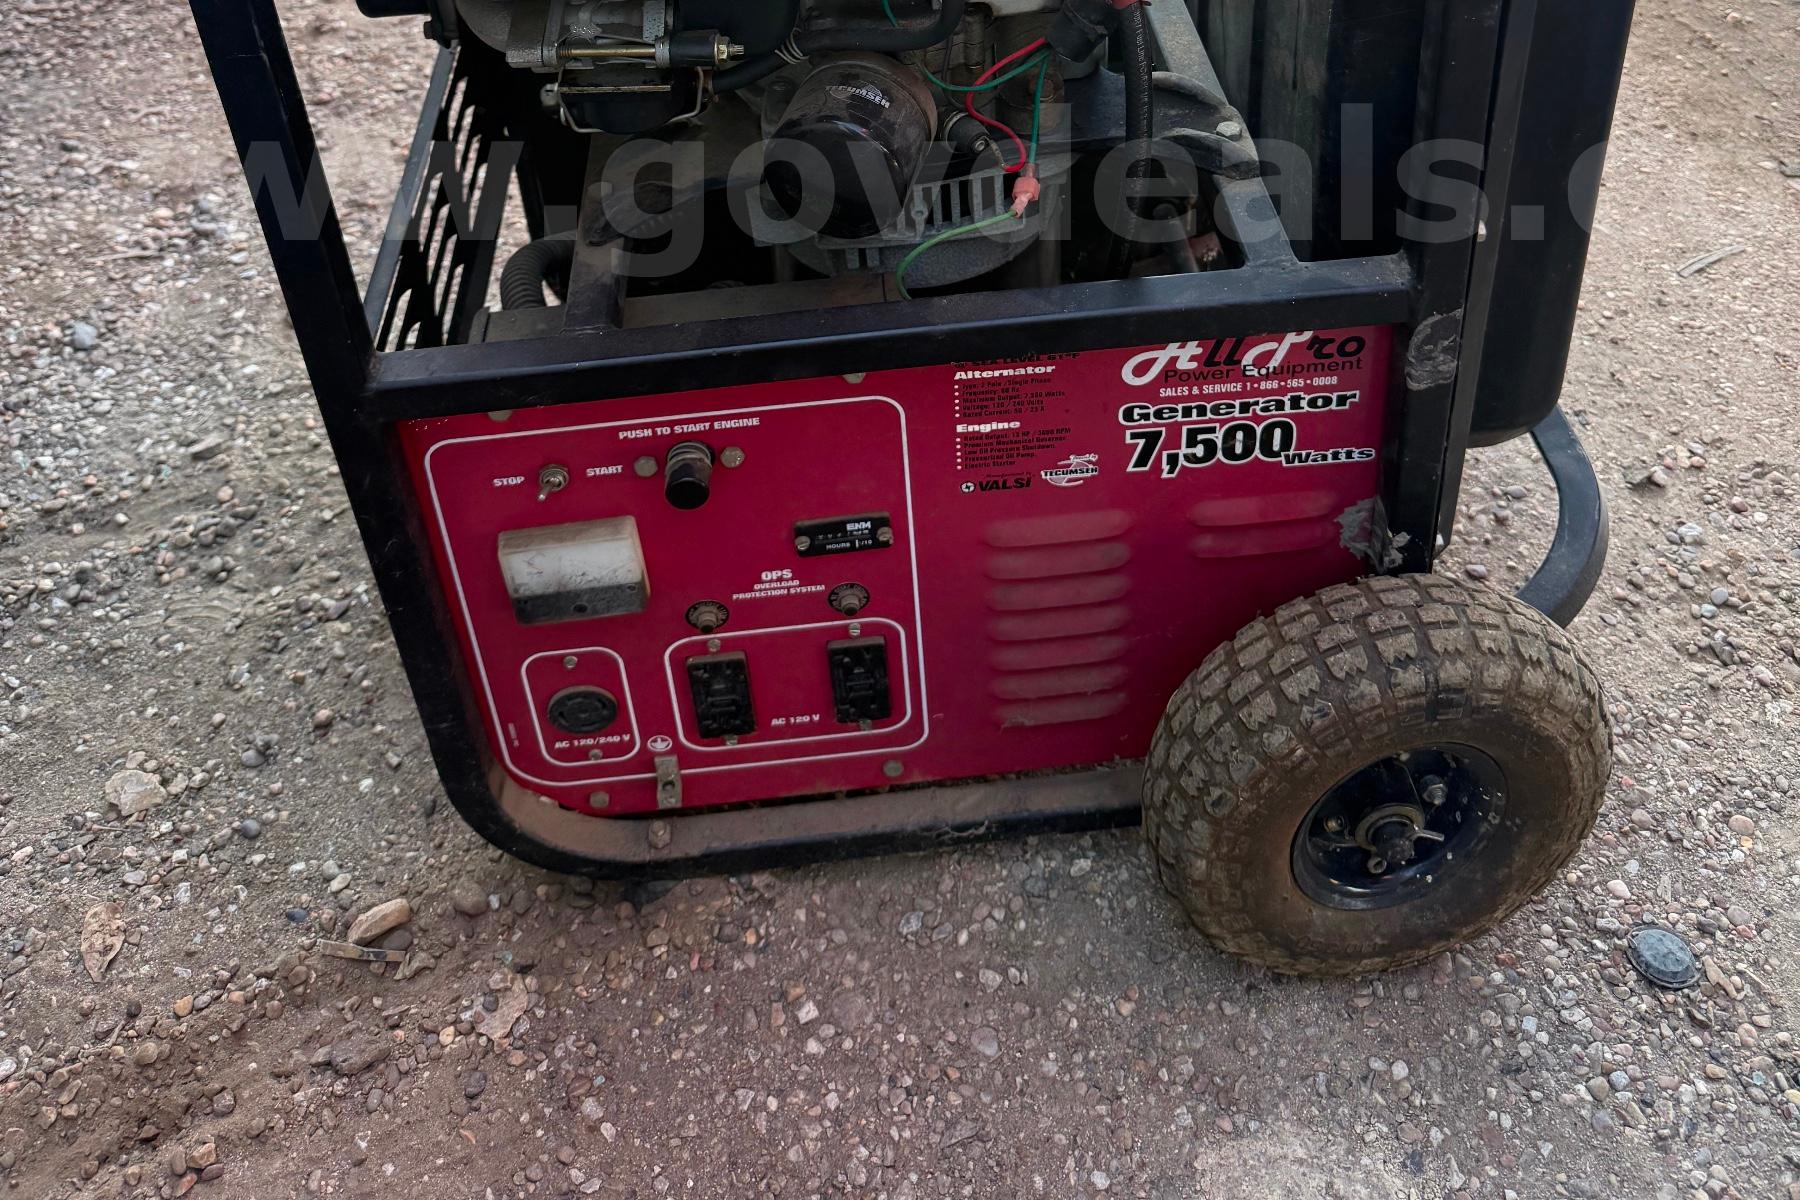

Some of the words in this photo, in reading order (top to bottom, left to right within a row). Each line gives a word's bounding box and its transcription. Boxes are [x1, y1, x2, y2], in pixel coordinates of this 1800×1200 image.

[953, 365, 1057, 380] Alternator
[1163, 367, 1236, 384] Power
[1241, 357, 1364, 380] Equipment
[1159, 386, 1189, 397] SALES
[1191, 386, 1200, 395] &
[1202, 382, 1242, 394] SERVICE
[1118, 390, 1360, 426] Generator
[618, 429, 653, 440] PUSH
[655, 426, 671, 436] TO
[673, 422, 711, 434] START
[713, 417, 761, 430] ENGINE
[956, 421, 1021, 433] Engine
[1126, 417, 1297, 479] 7,500
[1281, 447, 1376, 467] Watts
[493, 475, 526, 487] STOP
[586, 464, 624, 477] START
[1043, 466, 1098, 477] TECUMSEH
[978, 477, 1032, 491] VALSI
[825, 541, 851, 550] HOURS
[761, 568, 793, 580] OPS
[732, 588, 788, 600] PROTECTION
[789, 584, 826, 594] SYSTEM
[753, 579, 800, 590] OVERLOAD
[771, 717, 786, 726] AC
[789, 714, 811, 724] 120
[812, 713, 820, 721] V
[554, 740, 570, 749] AC
[573, 735, 621, 747] 120/240
[622, 733, 631, 741] V
